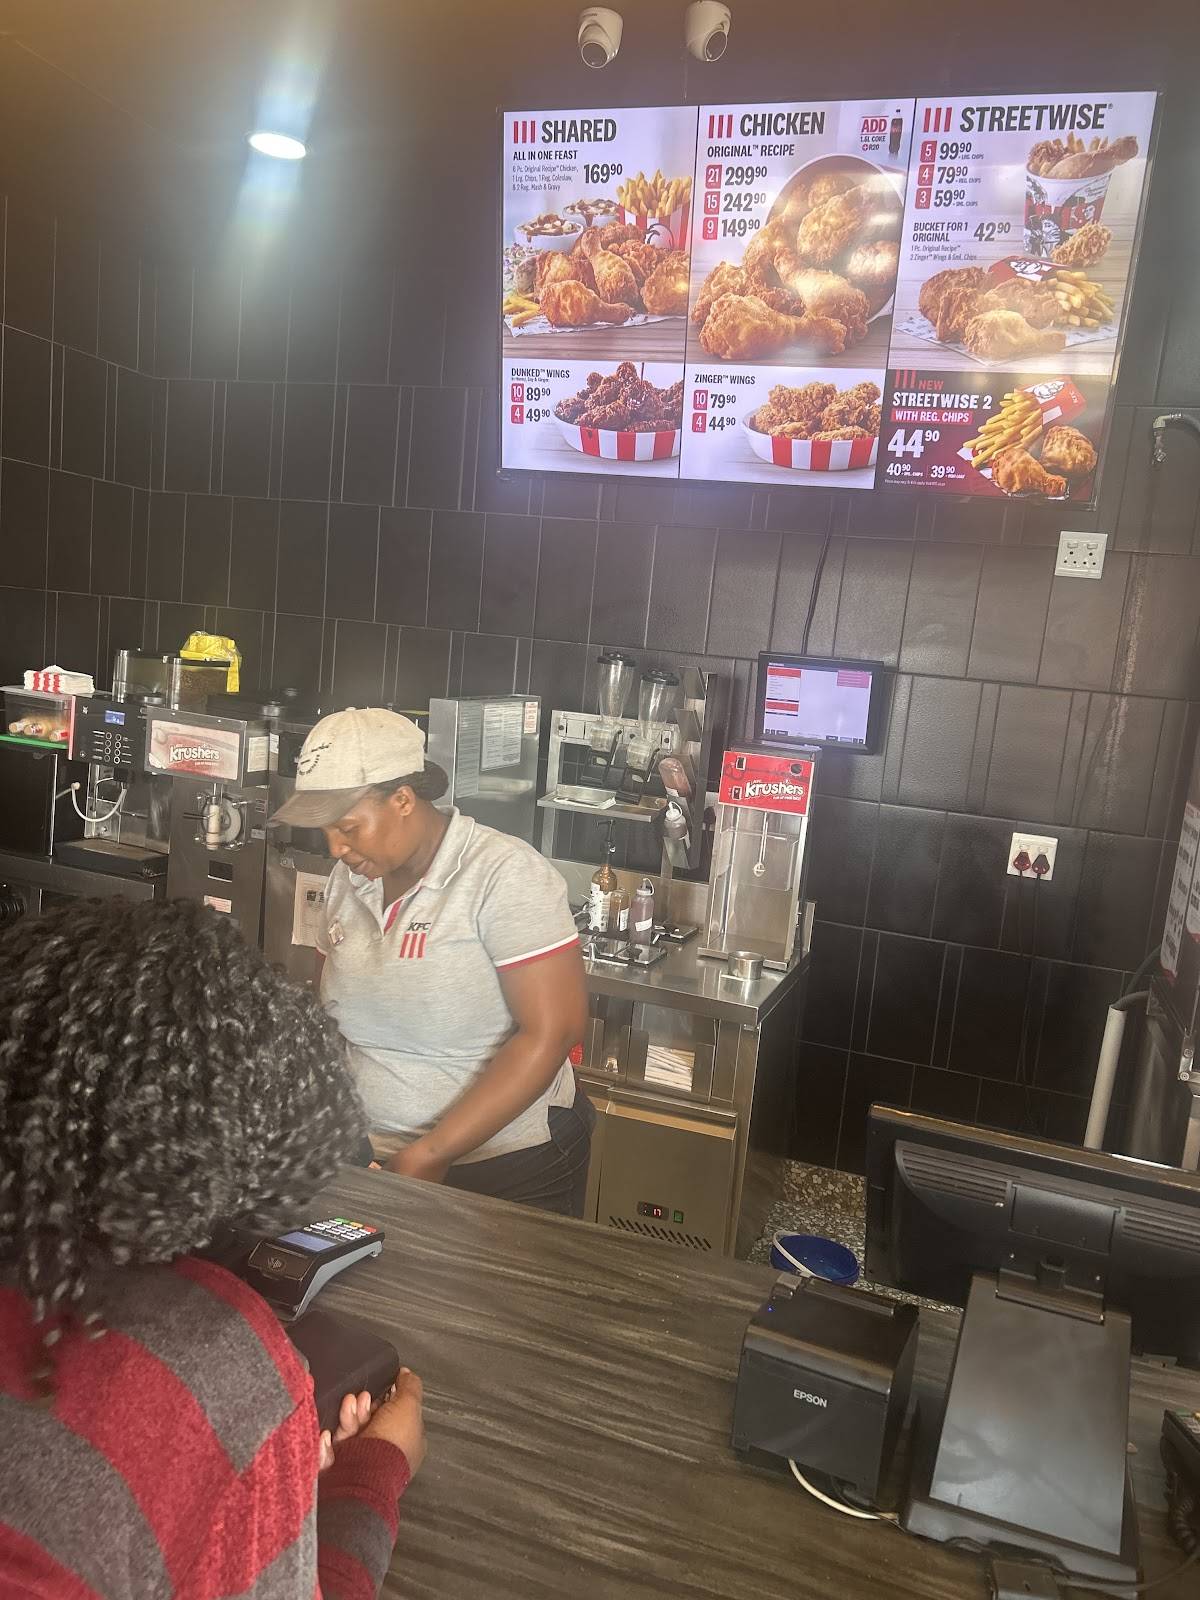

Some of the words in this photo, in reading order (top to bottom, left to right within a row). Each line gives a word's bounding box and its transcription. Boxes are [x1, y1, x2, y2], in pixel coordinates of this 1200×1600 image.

[739, 111, 825, 137] CHICKEN
[861, 118, 887, 133] ADD
[541, 119, 617, 144] SHARED
[513, 151, 526, 161] ALL
[528, 151, 536, 161] IN
[537, 151, 553, 160] ONE
[554, 150, 578, 160] FEAST
[760, 144, 795, 157] RECIPE
[925, 144, 932, 157] 5
[707, 168, 720, 183] 21
[922, 167, 929, 181] 4
[706, 194, 718, 209] 15
[919, 190, 927, 203] 3
[707, 220, 714, 234] 9
[913, 221, 945, 232] BUCKET
[946, 221, 963, 232] FOR
[912, 232, 950, 242] ORIGINAL
[546, 368, 570, 379] WINGS
[729, 375, 756, 385] WINGS
[512, 385, 523, 398] 10
[918, 380, 944, 390] NEW
[695, 392, 706, 405] 10
[892, 391, 979, 409] STREETWISE
[982, 395, 993, 410] 2
[514, 407, 521, 419] 4
[895, 410, 919, 422] WITH
[920, 411, 940, 422] REG.
[941, 411, 970, 423] CHIPS
[695, 415, 703, 428] 4
[745, 781, 804, 798] krushers
[407, 922, 431, 931] KFC
[793, 1389, 828, 1408] EPSON
